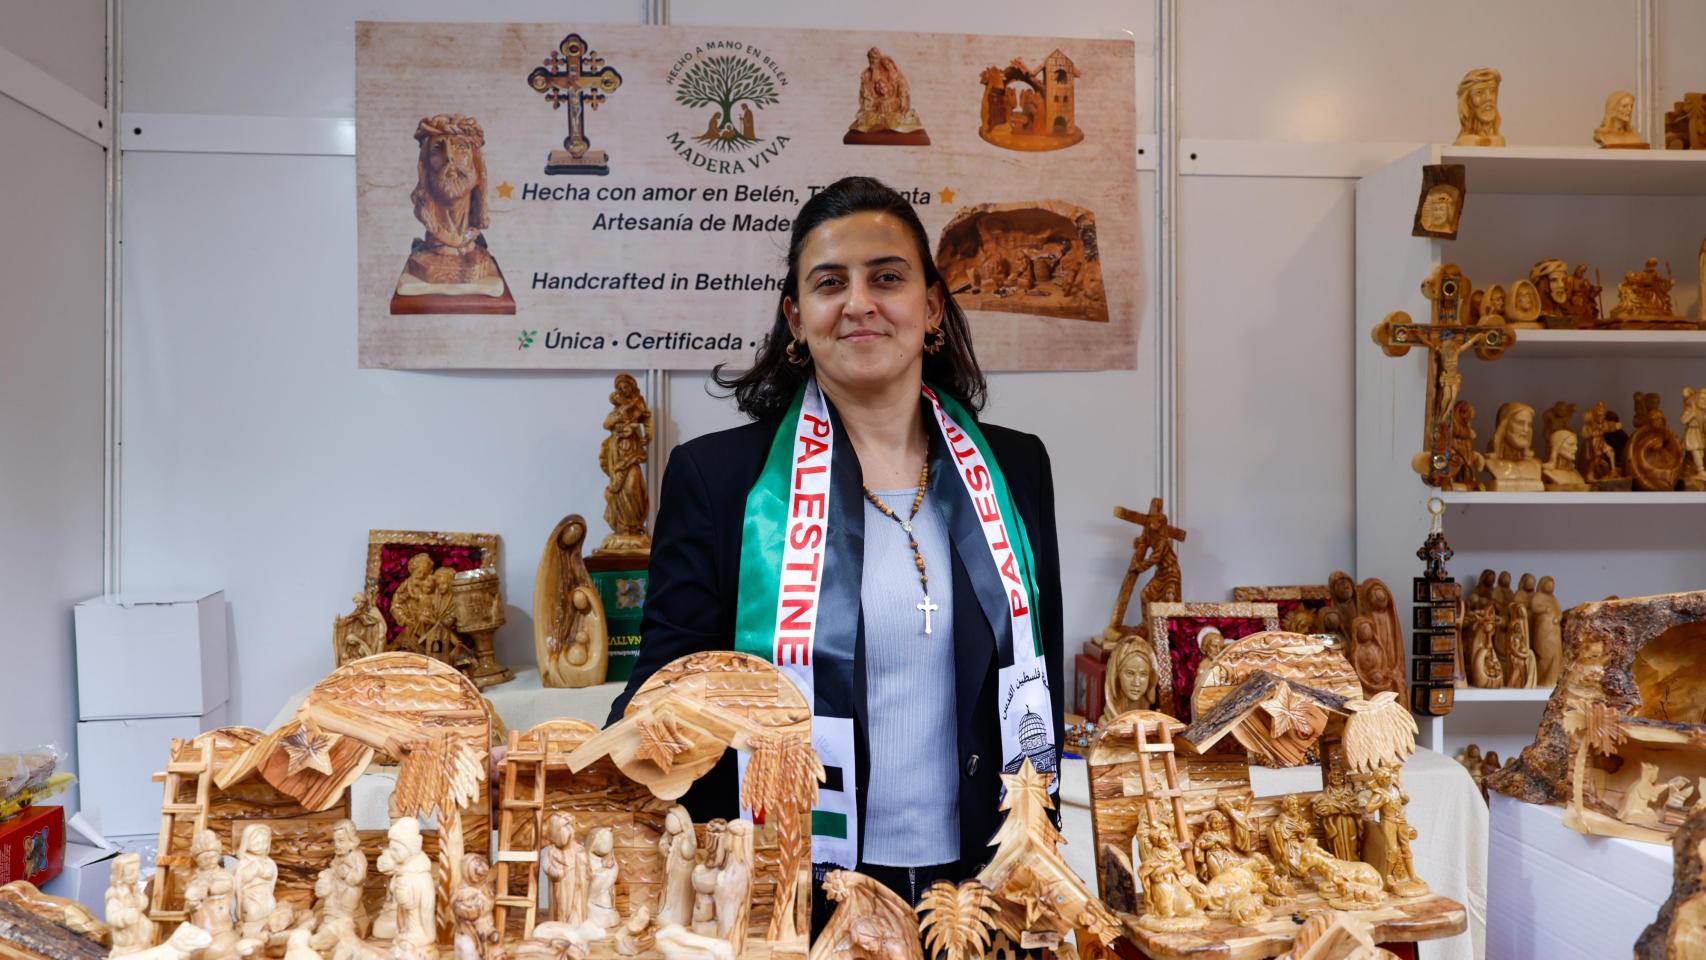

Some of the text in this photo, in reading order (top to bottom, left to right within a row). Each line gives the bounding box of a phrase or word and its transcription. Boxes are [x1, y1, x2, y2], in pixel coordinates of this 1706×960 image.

[666, 40, 788, 86] HECHO A MANO EN BELÉN
[666, 131, 791, 174] MADERA VIVA
[522, 183, 590, 201] Hecha
[596, 187, 636, 201] con
[642, 187, 697, 201] amor
[702, 187, 728, 202] en
[734, 185, 799, 206] Belén,
[901, 188, 931, 204] nta
[592, 213, 792, 232] Artesanía de Made
[532, 272, 787, 291] Handcrafted in Bethlehe
[545, 328, 605, 349] Única
[626, 332, 743, 351] Certificada
[777, 414, 830, 667] PALESTINE
